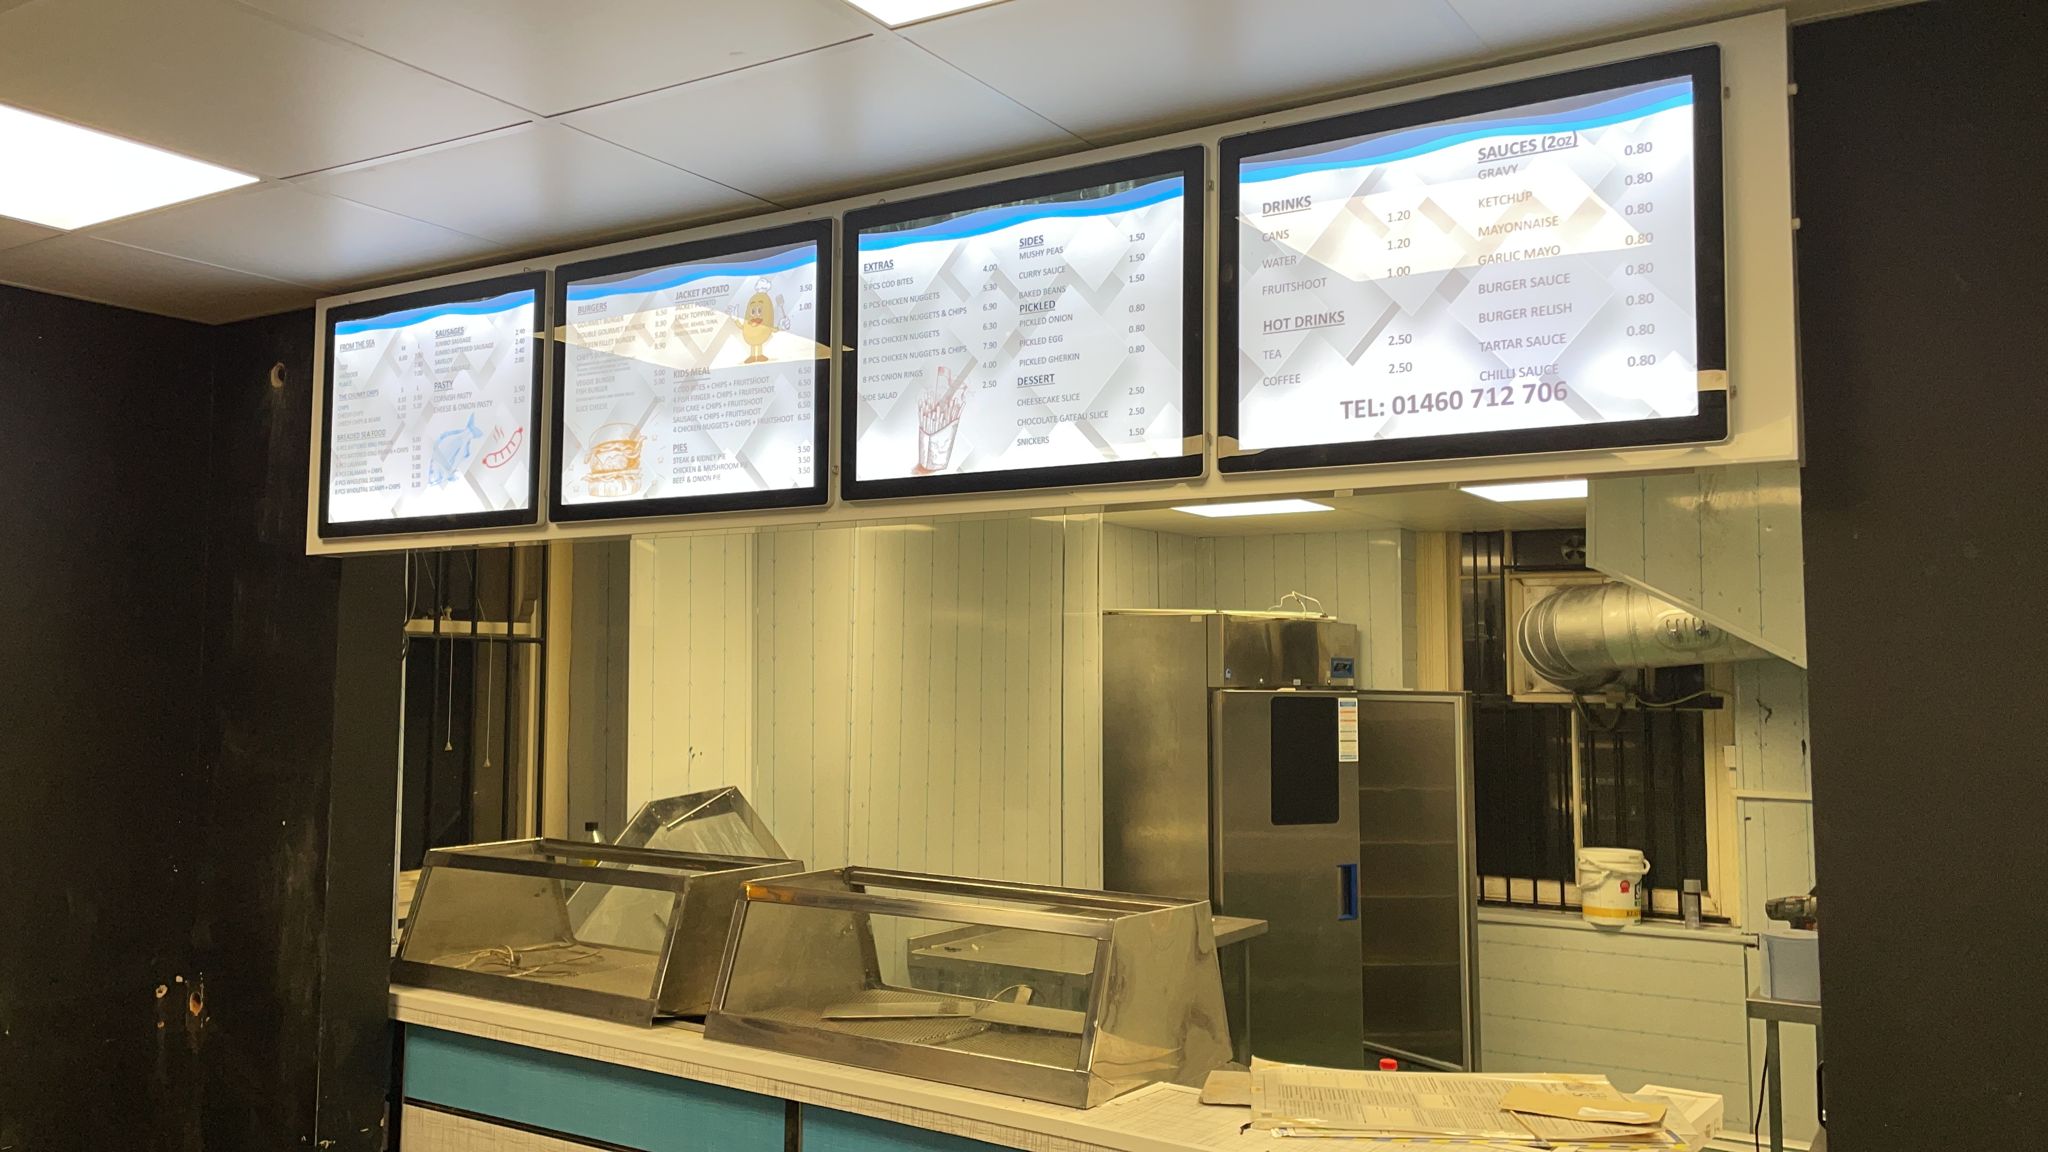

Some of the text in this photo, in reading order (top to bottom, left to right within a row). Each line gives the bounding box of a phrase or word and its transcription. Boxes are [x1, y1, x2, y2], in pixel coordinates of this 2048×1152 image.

[1477, 129, 1578, 163] SAUCES (2oz)
[1624, 141, 1653, 156] 0.80
[1477, 164, 1519, 180] GRAVY
[1624, 171, 1653, 186] 0.80
[1262, 195, 1312, 216] DRINKS
[1478, 191, 1533, 208] KETCHUP
[1625, 201, 1654, 216] 0.80
[1387, 209, 1411, 223] 1.20
[1478, 215, 1559, 237] MAYONNAISE
[1019, 234, 1044, 249] SIDES
[1128, 232, 1145, 242] 1.50
[1262, 229, 1290, 242] CANS
[1625, 231, 1654, 246] 0.80
[1387, 237, 1411, 250] 1.20
[1019, 246, 1064, 260] MUSHY PEAS
[1128, 253, 1145, 263] 1.50
[1478, 245, 1561, 266] GARLIC MAYO
[863, 259, 894, 273] EXTRAS
[982, 263, 998, 272] 4.00
[1262, 255, 1297, 268] WATER
[1018, 265, 1066, 279] CURRY SAUCE
[1387, 265, 1411, 279] 1.00
[1625, 262, 1654, 276] 0.80
[869, 282, 880, 290] PCS
[881, 279, 895, 289] COD
[896, 277, 914, 287] BITES
[1128, 273, 1145, 283] 1.50
[1478, 273, 1571, 294] BURGER SAUCE
[676, 284, 729, 300] JACKET POTATO
[800, 284, 812, 292] 3.50
[982, 283, 998, 292] 5.30
[1018, 285, 1066, 299] BAKED BEANS
[1262, 277, 1328, 296] FRUITSHOOT
[881, 296, 909, 307] CHICKEN
[909, 291, 940, 303] NUGGETS
[1626, 292, 1655, 306] 0.80
[577, 302, 607, 314] BURGERS
[982, 302, 998, 311] 6.90
[1019, 300, 1056, 314] PICKLED
[1128, 303, 1145, 313] 0.80
[1478, 302, 1573, 323] BURGER RELISH
[869, 319, 880, 328] PCS
[881, 315, 909, 326] CHICKEN
[909, 310, 940, 322] NUGGETS
[941, 309, 947, 317] &
[948, 306, 967, 316] CHIPS
[1019, 314, 1073, 327] PICKLED ONION
[1263, 310, 1345, 333] HOT DRINKS
[435, 327, 464, 338] SAUSAGES
[1128, 324, 1145, 333] 0.80
[1626, 323, 1656, 336] 0.80
[868, 338, 880, 346] PCS
[881, 334, 908, 345] CHICKEN
[909, 329, 940, 340] NUGGETS
[1019, 334, 1064, 347] PICKLED EGG
[1388, 333, 1412, 346] 2.50
[1479, 333, 1567, 352] TARTAR SAUCE
[355, 341, 365, 350] THE
[366, 339, 375, 348] SEA
[982, 341, 998, 350] 7.90
[1128, 344, 1145, 354] 0.80
[868, 356, 880, 364] PCS
[881, 352, 908, 363] CHICKEN
[909, 348, 940, 359] NUGGETS
[940, 347, 946, 355] &
[948, 345, 967, 354] CHIPS
[1019, 352, 1080, 367] PICKLED GHERKIN
[1263, 349, 1282, 360] TEA
[1627, 354, 1656, 367] 0.80
[982, 361, 998, 369] 4.00
[1388, 361, 1413, 374] 2.50
[673, 367, 711, 379] KIDS MEAL
[868, 375, 880, 383] PCS
[881, 372, 902, 382] ONION
[903, 369, 923, 378] RINGS
[1479, 363, 1559, 381] CHILLI SAUCE
[434, 380, 454, 391] PASTY
[982, 380, 998, 389] 2.50
[1017, 373, 1055, 387] DESSERT
[1263, 373, 1301, 386] COFFEE
[457, 392, 472, 400] PASTY
[878, 391, 898, 400] SALAD
[1128, 386, 1145, 396] 2.50
[477, 400, 493, 408] PASTY
[798, 401, 811, 409] 6.50
[1017, 392, 1080, 407] CHEESECAKE SLICE
[1339, 381, 1568, 419] TEL: 01460 712 706
[673, 415, 698, 423] SAUSAGE
[703, 411, 720, 420] CHIPS
[725, 407, 761, 418] FRUITSHOOT
[798, 413, 811, 421] 6.50
[1128, 406, 1145, 416] 2.50
[1017, 410, 1109, 427] CHOCOLATE GATEAU SLICE
[677, 423, 702, 433] CHICKEN
[702, 421, 729, 431] NUGGETS
[735, 419, 751, 428] CHIPS
[1128, 427, 1145, 436] 1.50
[1017, 436, 1050, 446] SNICKERS
[673, 443, 688, 454] PIES
[673, 465, 697, 474] CHICKEN
[703, 462, 739, 472] MUSHROOM
